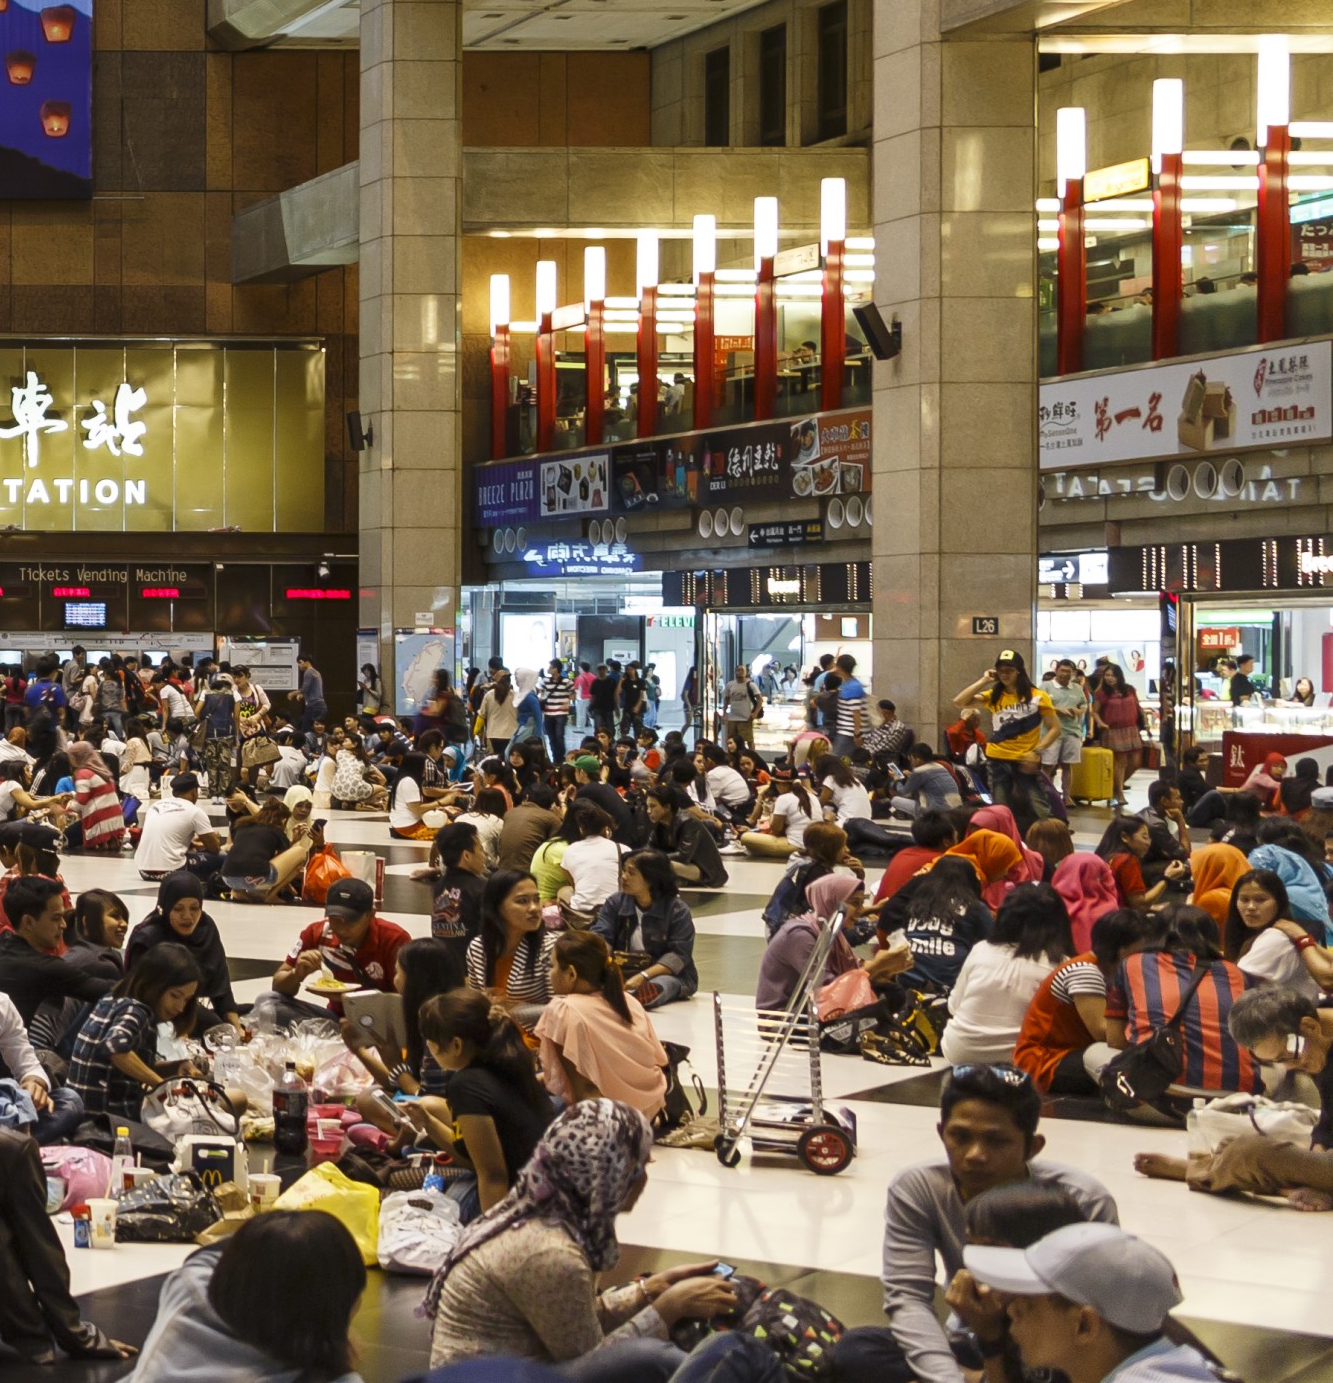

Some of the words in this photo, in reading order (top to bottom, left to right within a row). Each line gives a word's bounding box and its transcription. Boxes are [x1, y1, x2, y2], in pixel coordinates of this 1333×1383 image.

[1095, 391, 1163, 442] 第一名
[19, 567, 70, 582] Tickets
[77, 568, 128, 583] Vending
[136, 569, 187, 582] Machine
[976, 619, 996, 633] L26
